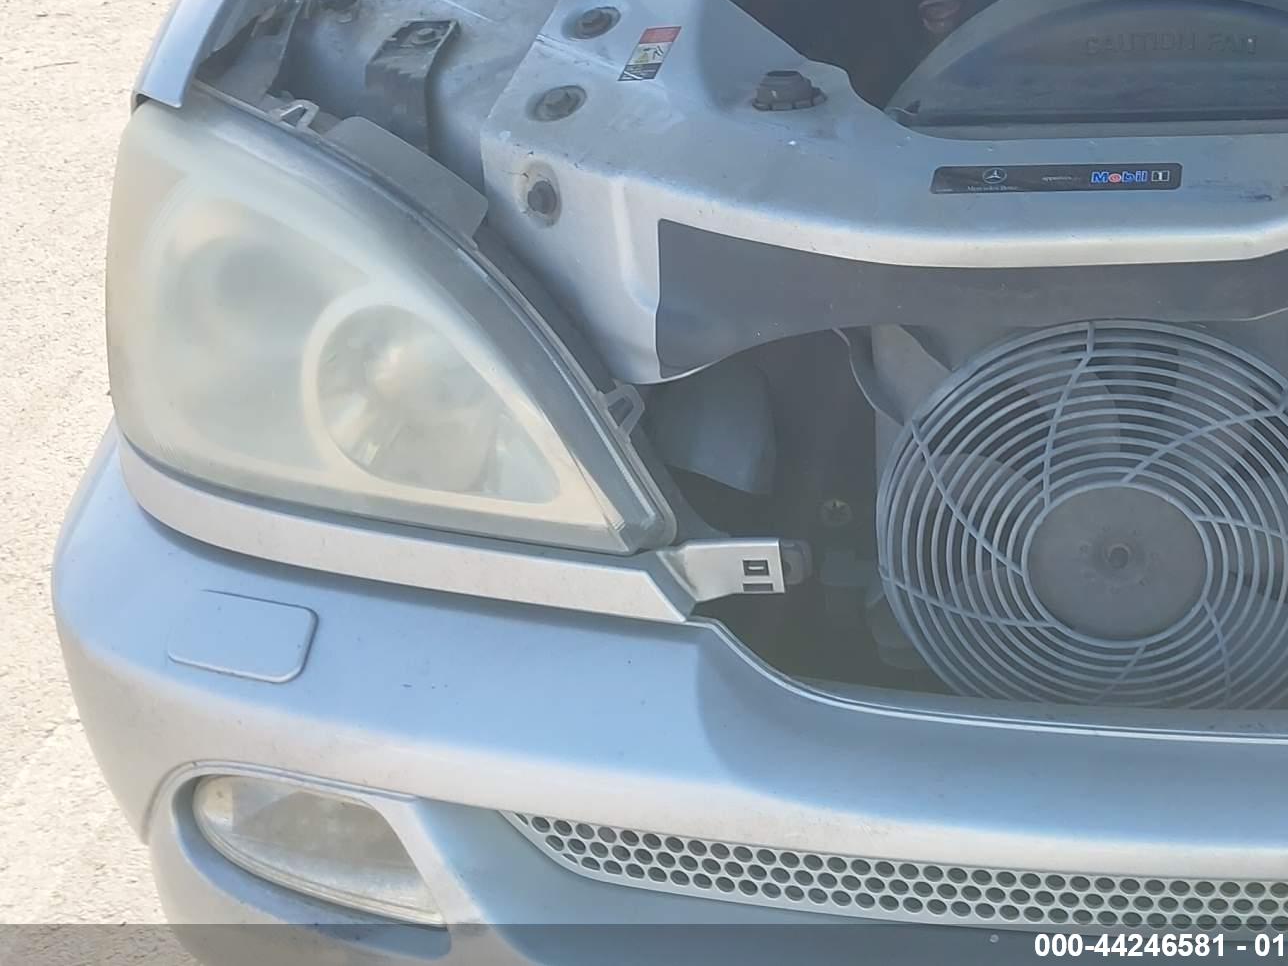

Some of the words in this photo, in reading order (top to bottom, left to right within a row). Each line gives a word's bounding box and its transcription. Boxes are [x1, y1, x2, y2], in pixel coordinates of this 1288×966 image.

[1085, 32, 1197, 55] CAUTION
[1207, 33, 1257, 55] FAN
[1091, 170, 1148, 184] Mobil
